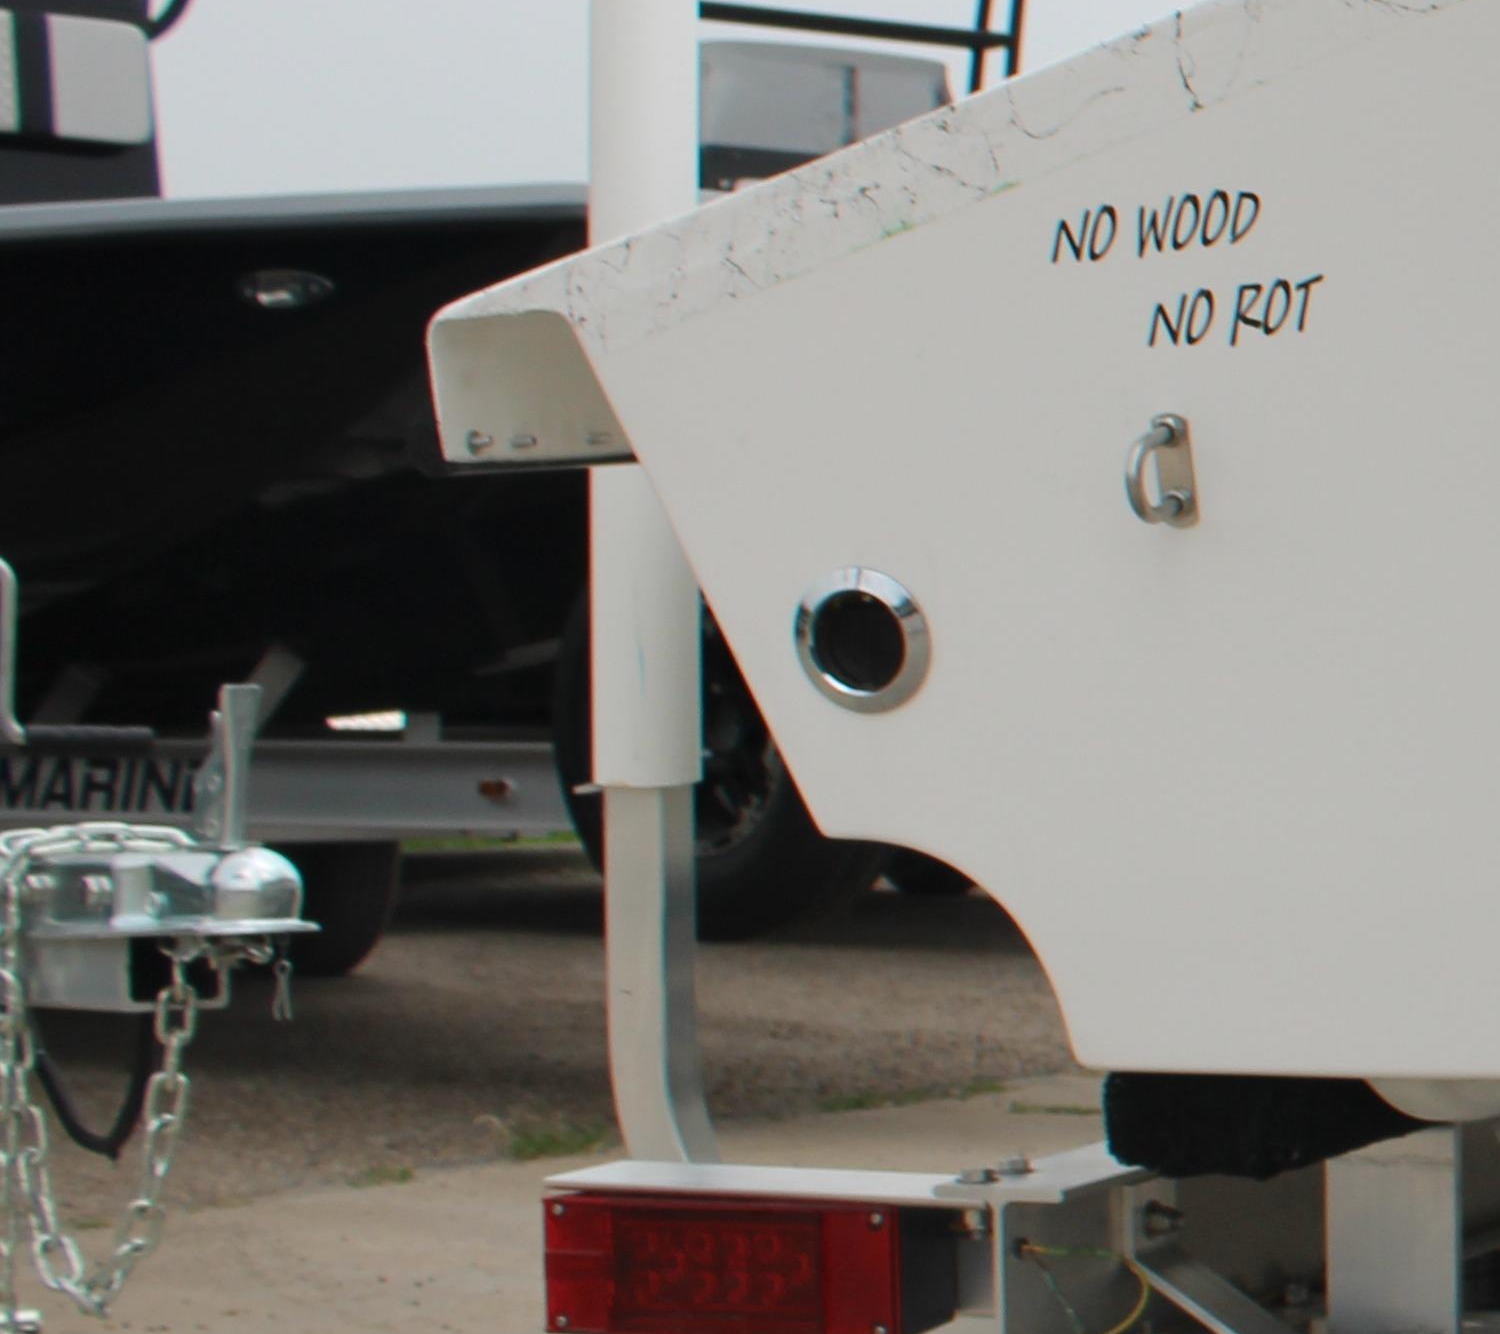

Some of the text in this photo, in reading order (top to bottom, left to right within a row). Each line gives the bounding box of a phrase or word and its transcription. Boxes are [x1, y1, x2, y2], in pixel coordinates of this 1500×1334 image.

[1051, 188, 1261, 264] NO WOOD
[1148, 273, 1325, 348] NO ROT
